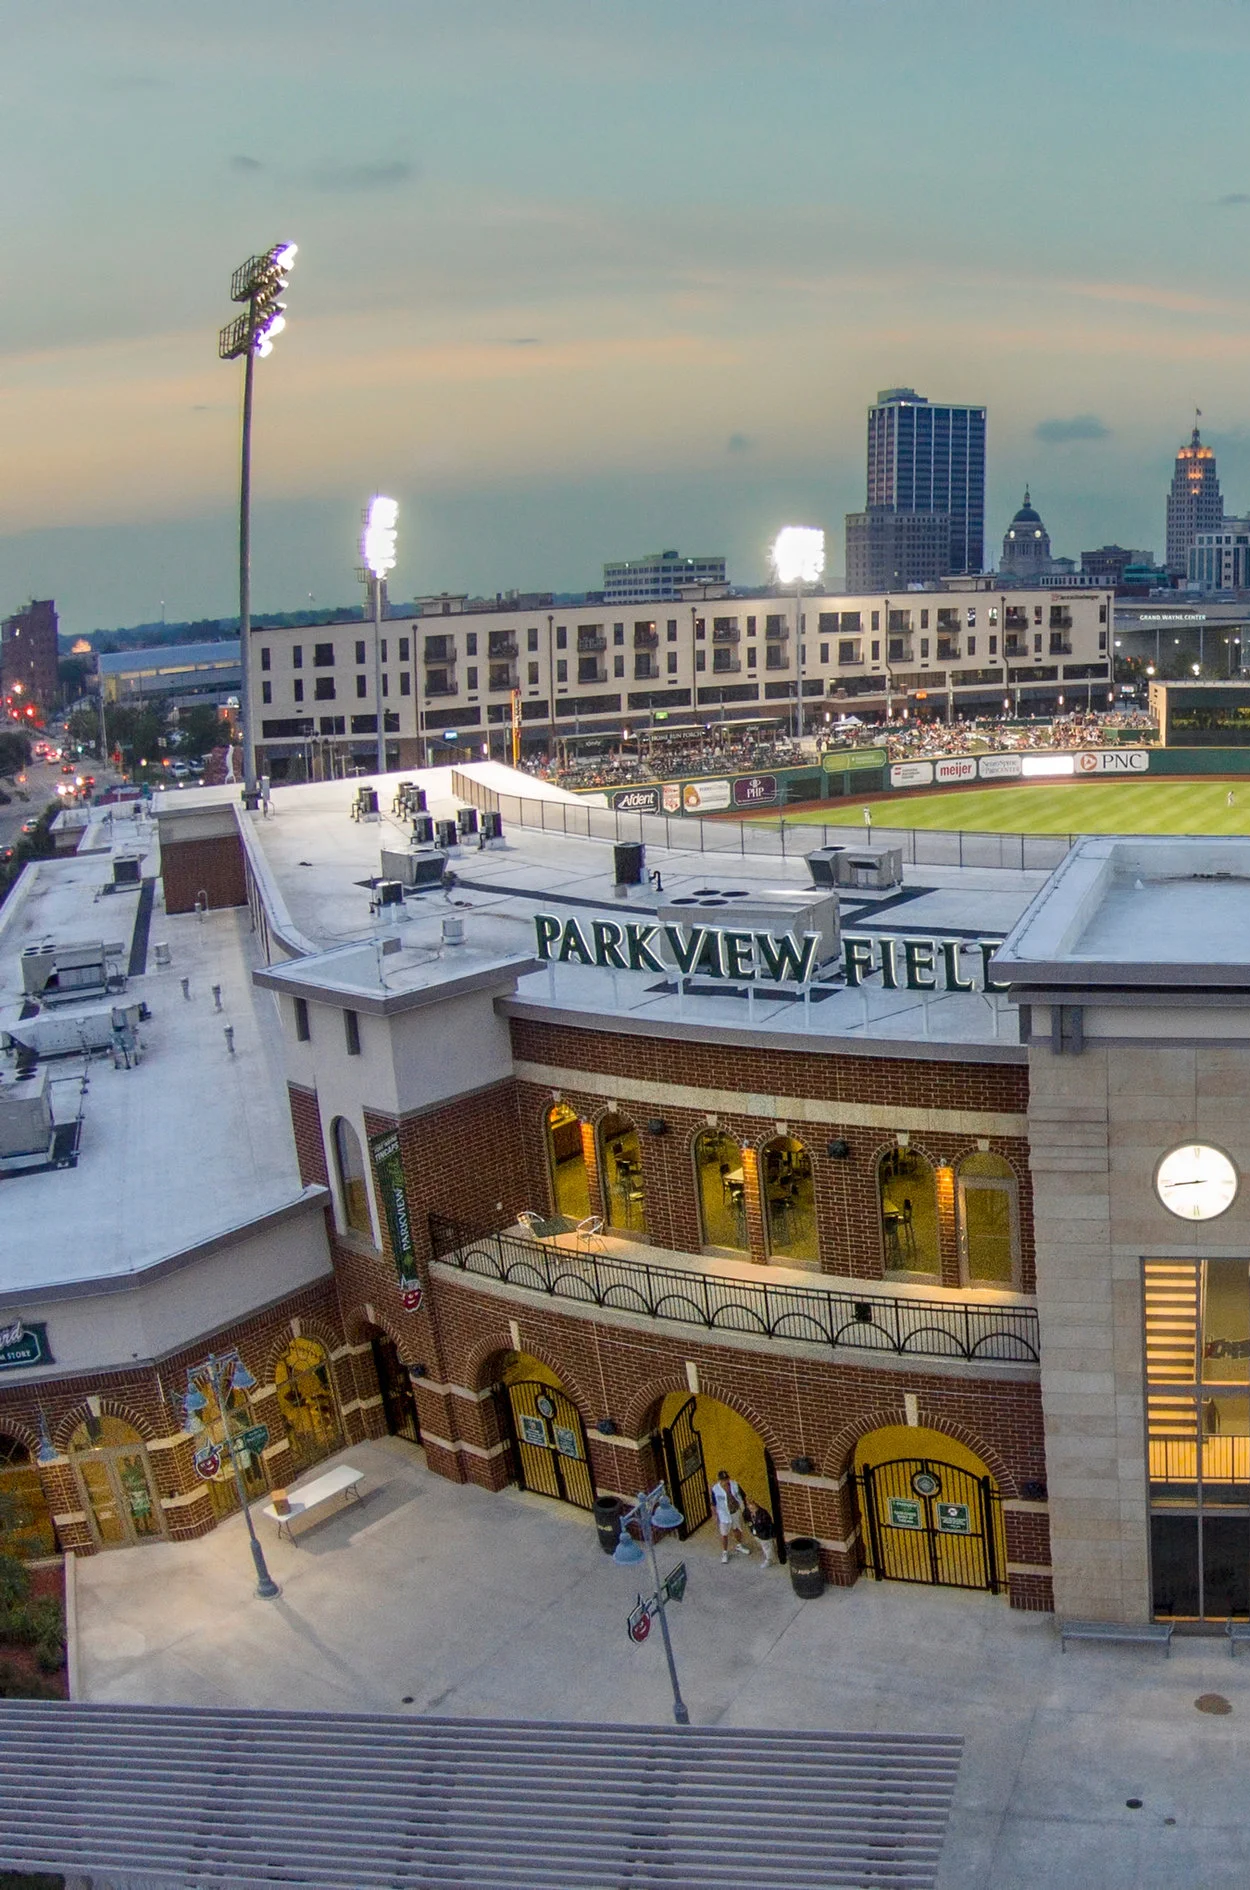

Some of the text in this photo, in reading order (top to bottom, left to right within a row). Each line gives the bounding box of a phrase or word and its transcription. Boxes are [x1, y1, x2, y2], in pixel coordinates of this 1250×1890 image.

[1103, 754, 1142, 769] PNC
[940, 762, 972, 777] meijer
[622, 793, 654, 806] Afdent
[746, 787, 764, 798] PHP
[533, 913, 820, 984] PARKVIEW
[394, 1187, 411, 1251] PARKVIEW
[7, 1350, 31, 1360] STORE
